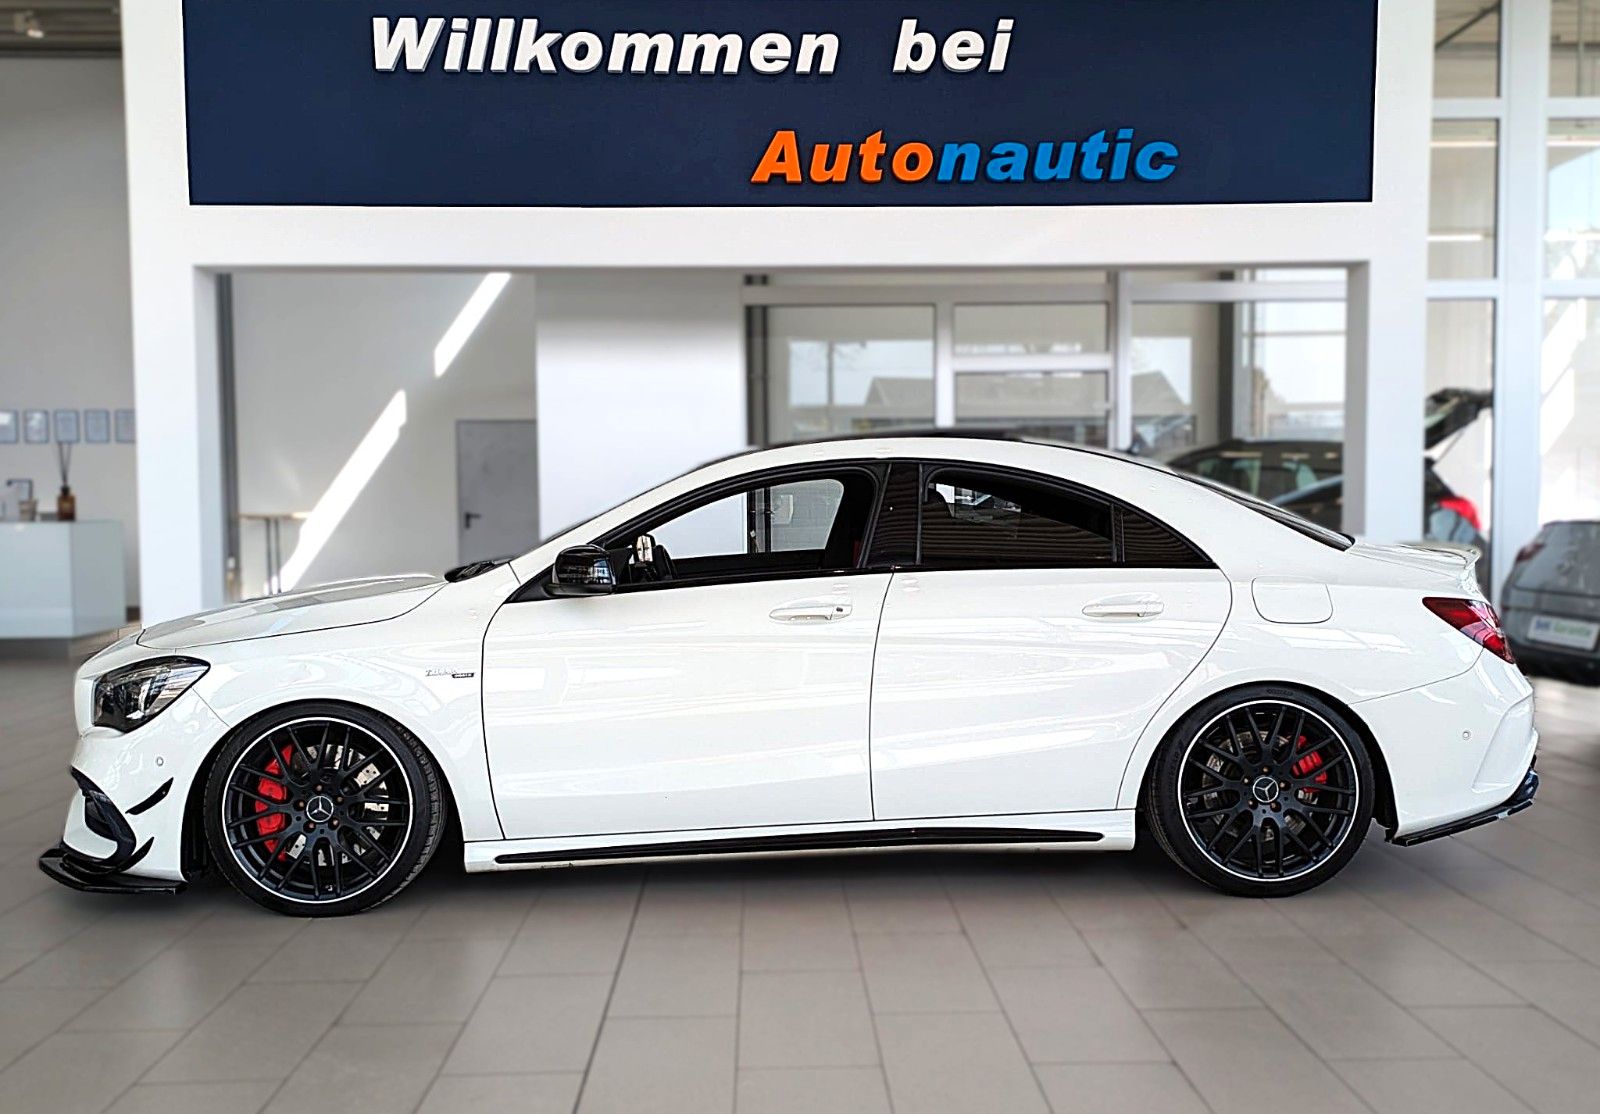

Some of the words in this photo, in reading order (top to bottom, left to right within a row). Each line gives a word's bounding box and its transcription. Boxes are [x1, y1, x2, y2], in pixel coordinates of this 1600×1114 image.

[372, 17, 839, 74] Willkommen
[892, 18, 1014, 73] bei
[750, 128, 1179, 184] Autonautic
